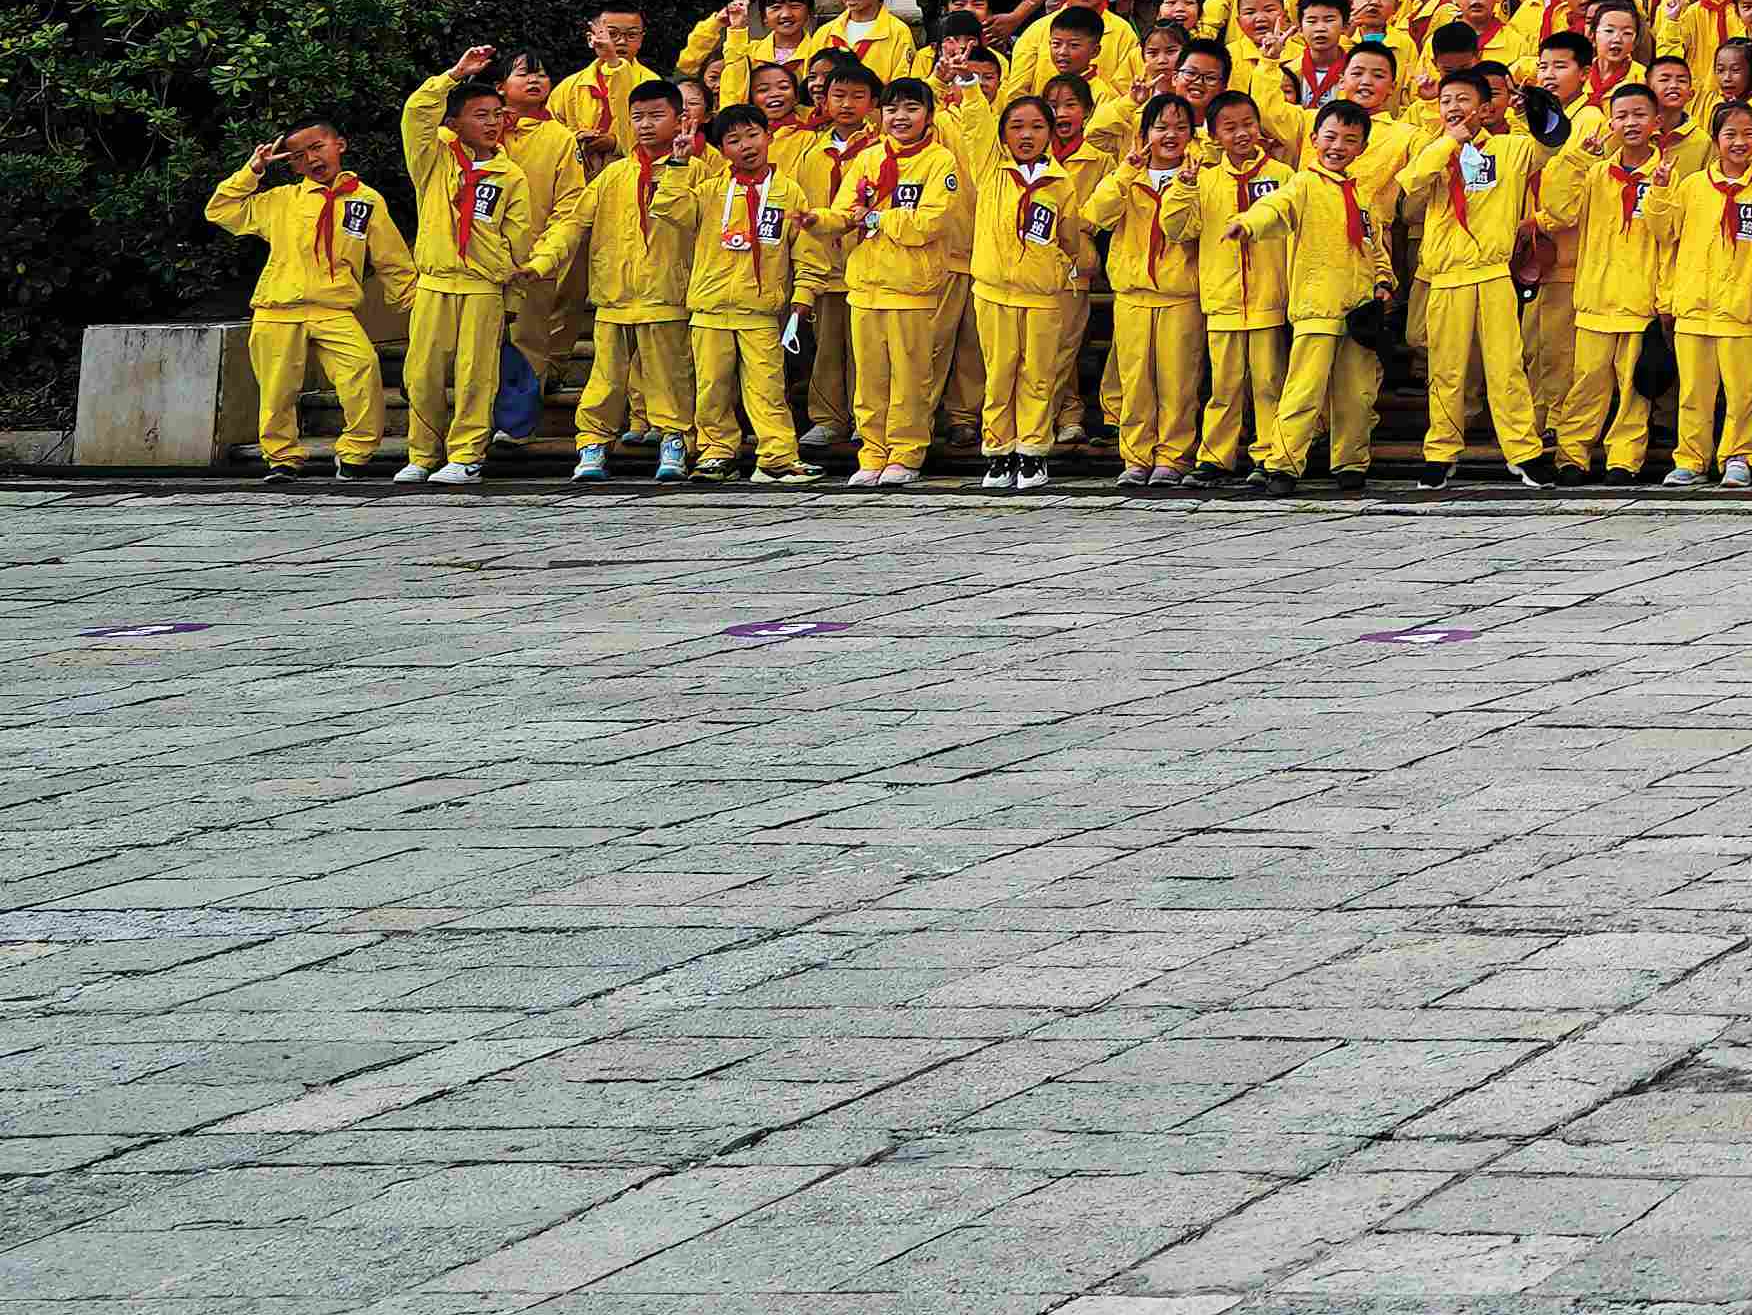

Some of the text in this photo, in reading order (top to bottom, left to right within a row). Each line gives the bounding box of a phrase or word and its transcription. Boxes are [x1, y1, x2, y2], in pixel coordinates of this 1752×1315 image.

[477, 184, 496, 201] (1)
[897, 186, 918, 201] (1)
[351, 202, 368, 219] (1)
[1034, 205, 1050, 221] (1)
